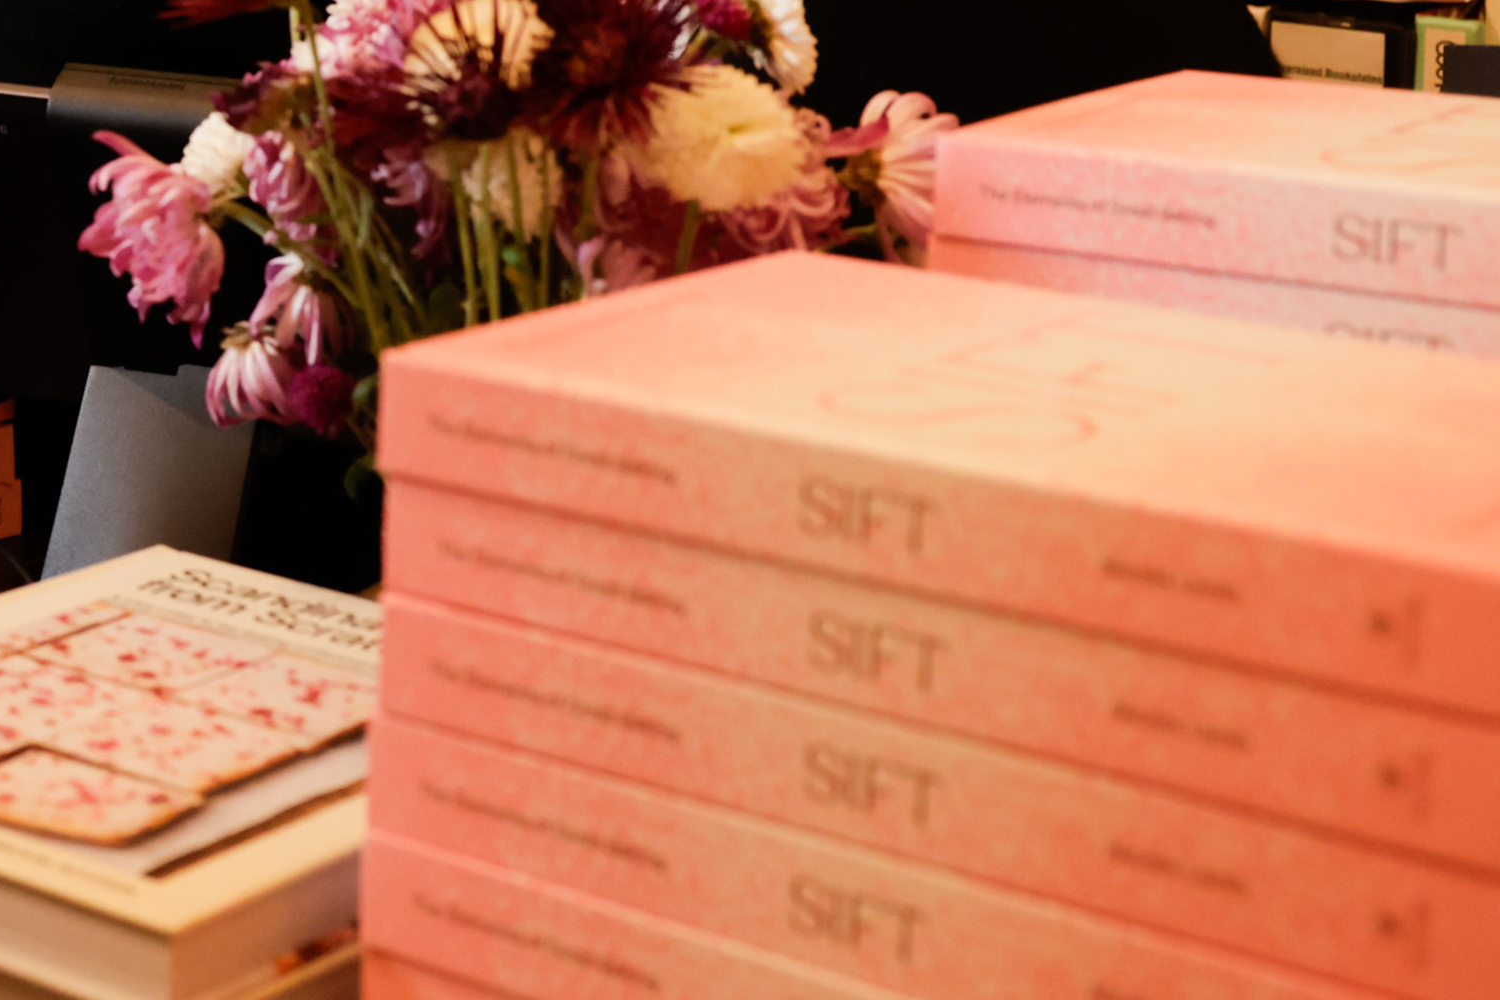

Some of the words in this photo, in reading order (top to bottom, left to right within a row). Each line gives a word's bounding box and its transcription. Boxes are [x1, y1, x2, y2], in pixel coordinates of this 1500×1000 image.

[1330, 212, 1463, 271] SIFT
[798, 473, 942, 555] SIFT
[136, 578, 248, 616] from
[808, 608, 948, 697] SIFT
[802, 740, 946, 832] SIFT
[788, 873, 930, 965] SIFT
